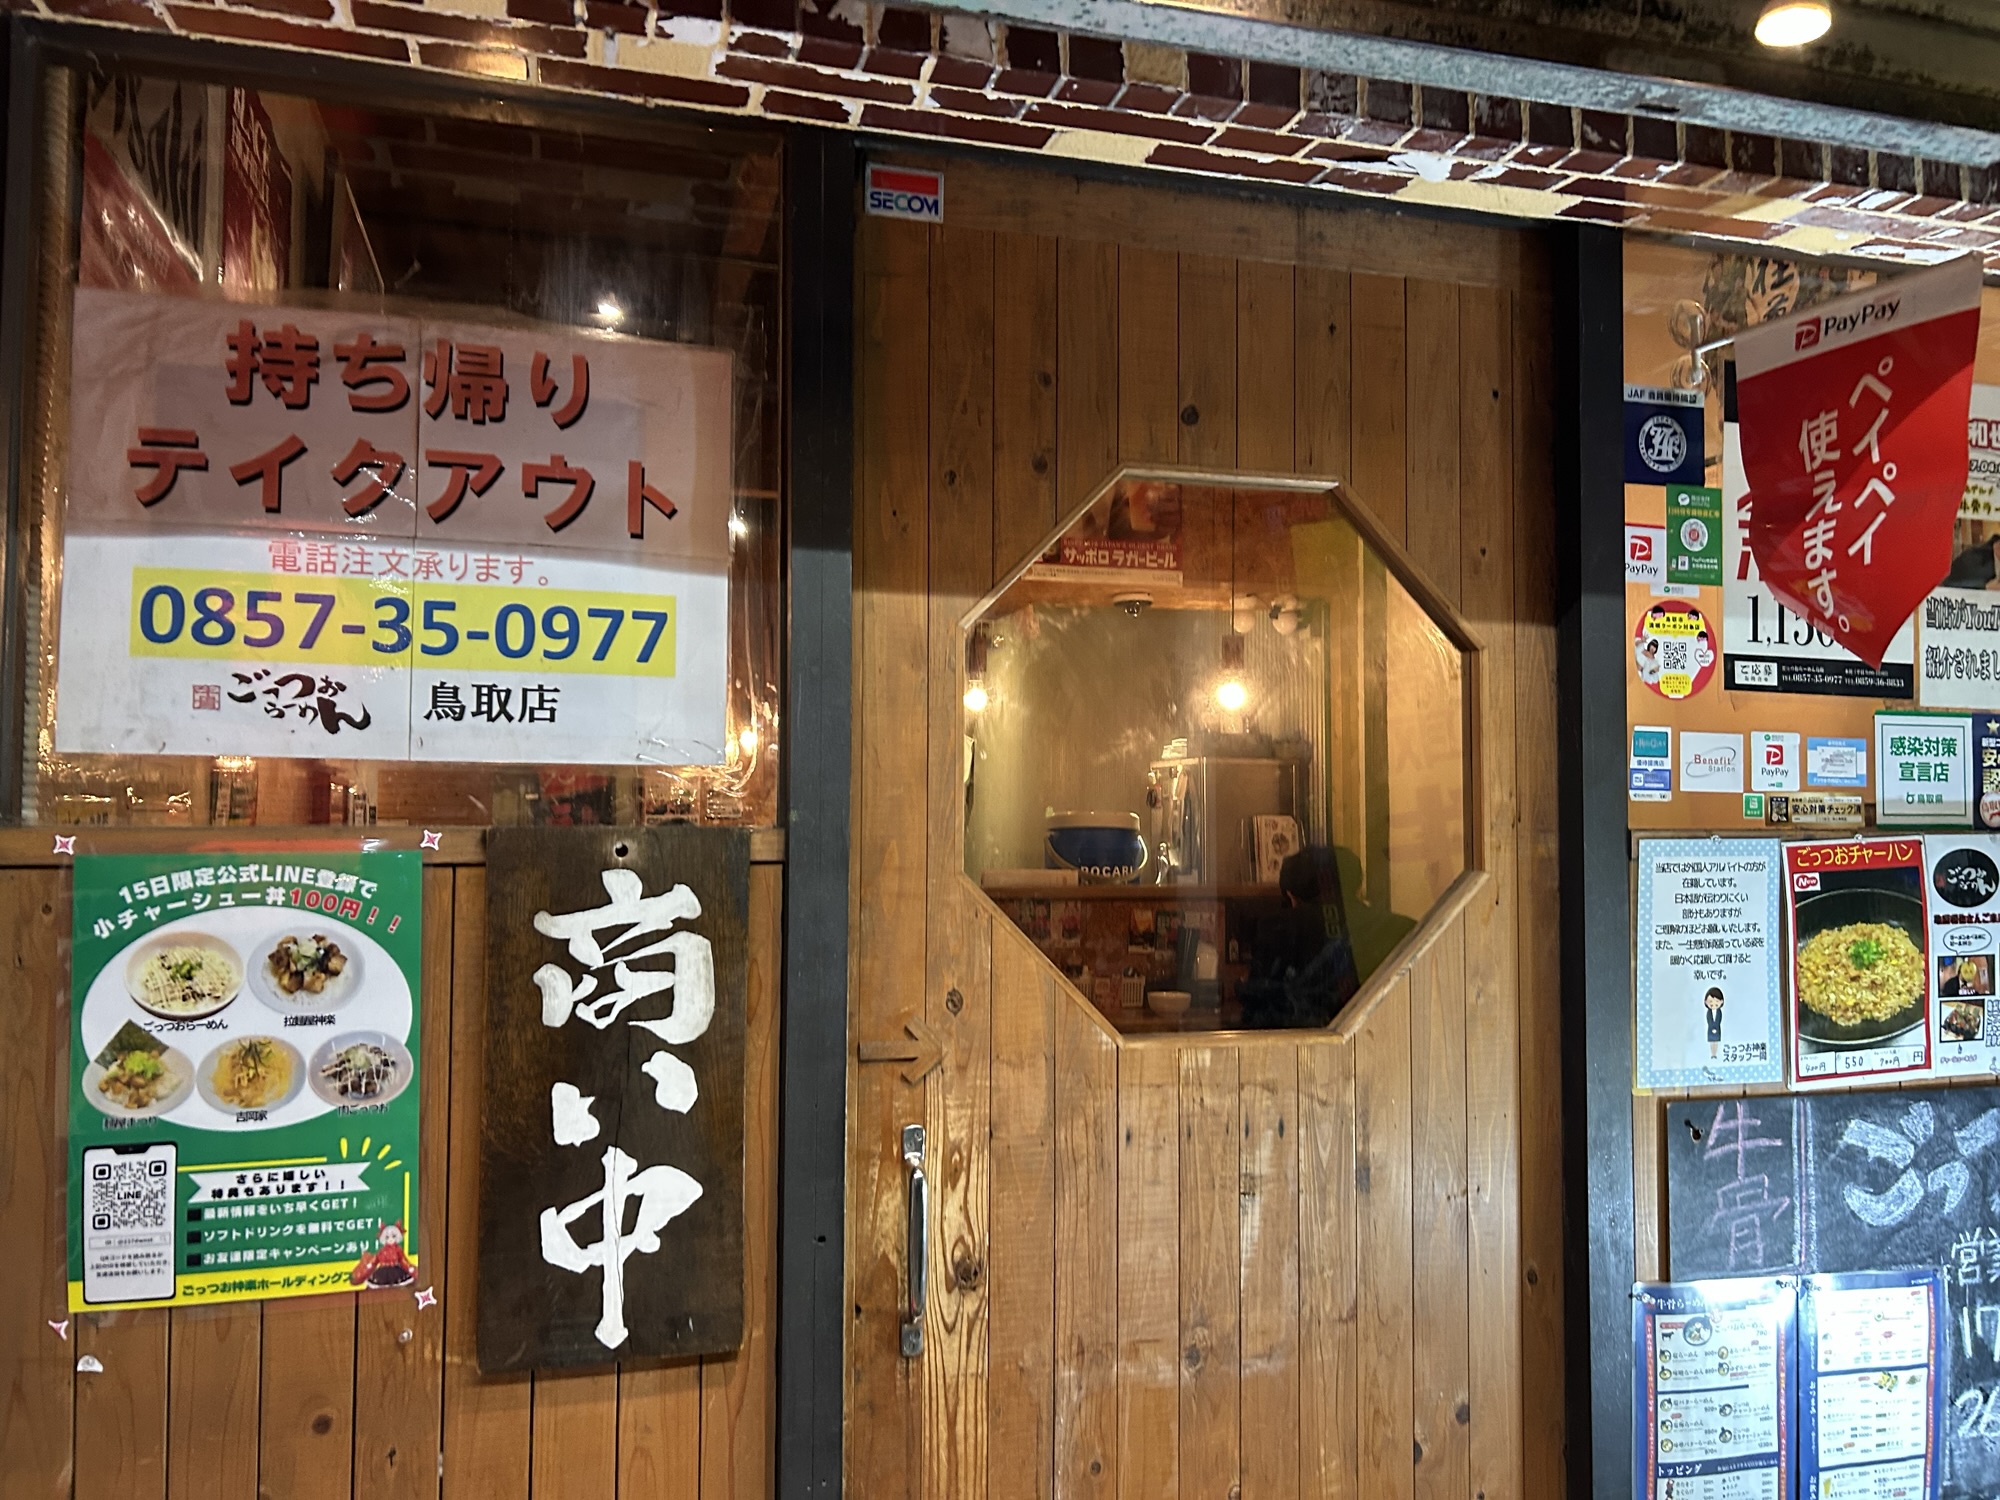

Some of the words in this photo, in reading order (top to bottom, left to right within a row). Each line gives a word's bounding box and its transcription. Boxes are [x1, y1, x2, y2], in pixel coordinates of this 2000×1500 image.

[870, 190, 939, 216] SECOM
[1823, 299, 1901, 337] PayPay
[224, 319, 590, 429] 持ち帰り
[1847, 355, 1897, 565] ペイペイ
[127, 427, 679, 540] テイクアウト
[1798, 410, 1850, 633] 使えます。
[268, 538, 550, 587] 電話注文承ります。
[1063, 546, 1110, 565] サッポロ
[1111, 548, 1177, 569] ラガービール
[1625, 563, 1659, 576] PayPay
[138, 584, 669, 664] 0857-35-0977
[423, 680, 562, 724] 鳥取店
[1694, 753, 1732, 765] Benefit
[1889, 736, 1958, 758] 感染対策
[1708, 765, 1736, 773] Station
[1761, 767, 1789, 778] PayPay
[1898, 761, 1950, 783] 宣言店
[1917, 793, 1944, 804] 鳥取県
[1796, 842, 1914, 867] ごっつおチャーハン
[118, 864, 379, 905] 15日限定公式LINE登録で
[142, 1019, 229, 1033] ごっつおらーめん
[1844, 1056, 1864, 1069] 550
[117, 1190, 142, 1200] LINE
[1703, 1100, 1790, 1270] 牛骨
[1658, 1463, 1702, 1477] トッピング
